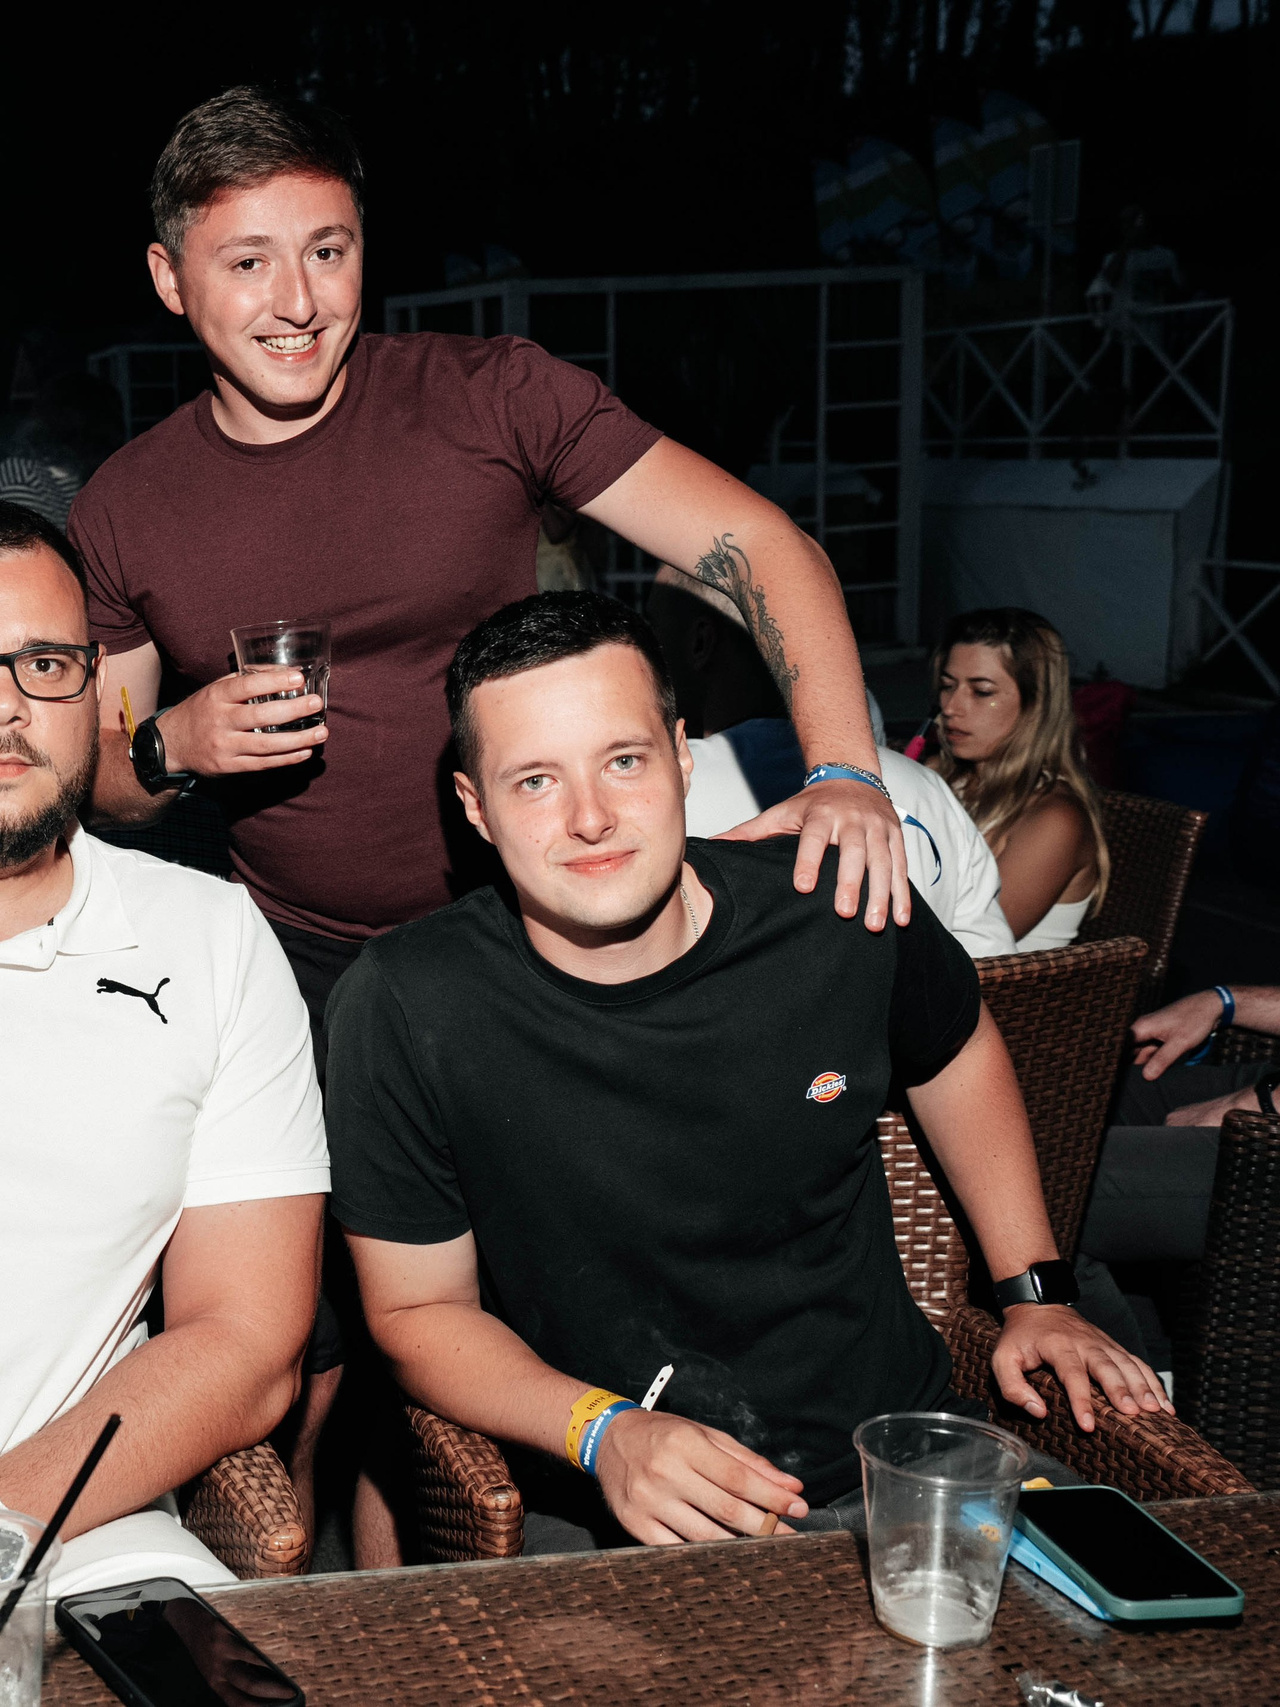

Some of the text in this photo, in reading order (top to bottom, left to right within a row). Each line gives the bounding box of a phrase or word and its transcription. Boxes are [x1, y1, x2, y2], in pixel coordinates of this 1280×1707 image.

[811, 1079, 843, 1096] Dickies
[584, 1416, 604, 1466] БЕРИ ЗАРЯД
